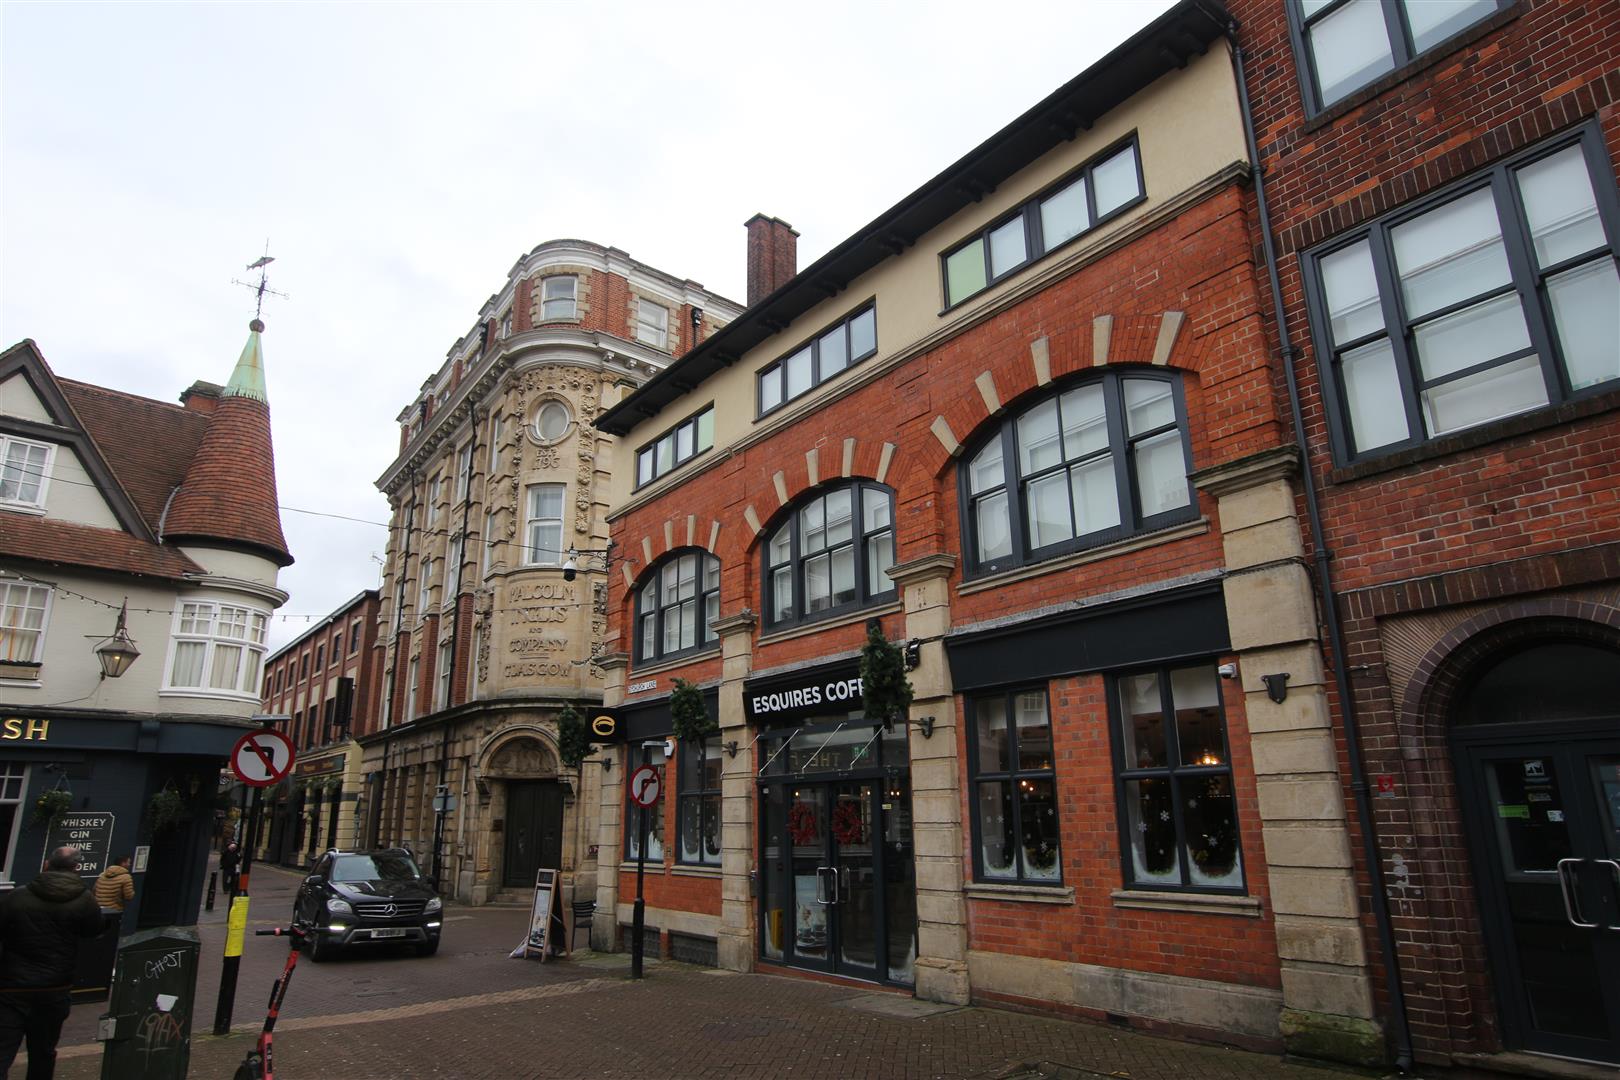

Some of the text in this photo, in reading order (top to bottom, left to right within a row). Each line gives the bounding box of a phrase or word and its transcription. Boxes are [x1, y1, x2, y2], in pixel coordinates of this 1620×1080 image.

[509, 585, 577, 603] MALCOLM
[510, 605, 568, 626] INGLIS
[510, 639, 569, 653] COMPANY
[503, 662, 573, 677] GLASGOW
[752, 678, 865, 714] ESQUIRES COFF
[0, 718, 50, 741] SH
[60, 818, 106, 828] WHISKEY
[69, 830, 90, 839] GIN
[65, 842, 92, 851] WINE
[75, 862, 97, 872] DEN
[144, 949, 188, 979] GHOST
